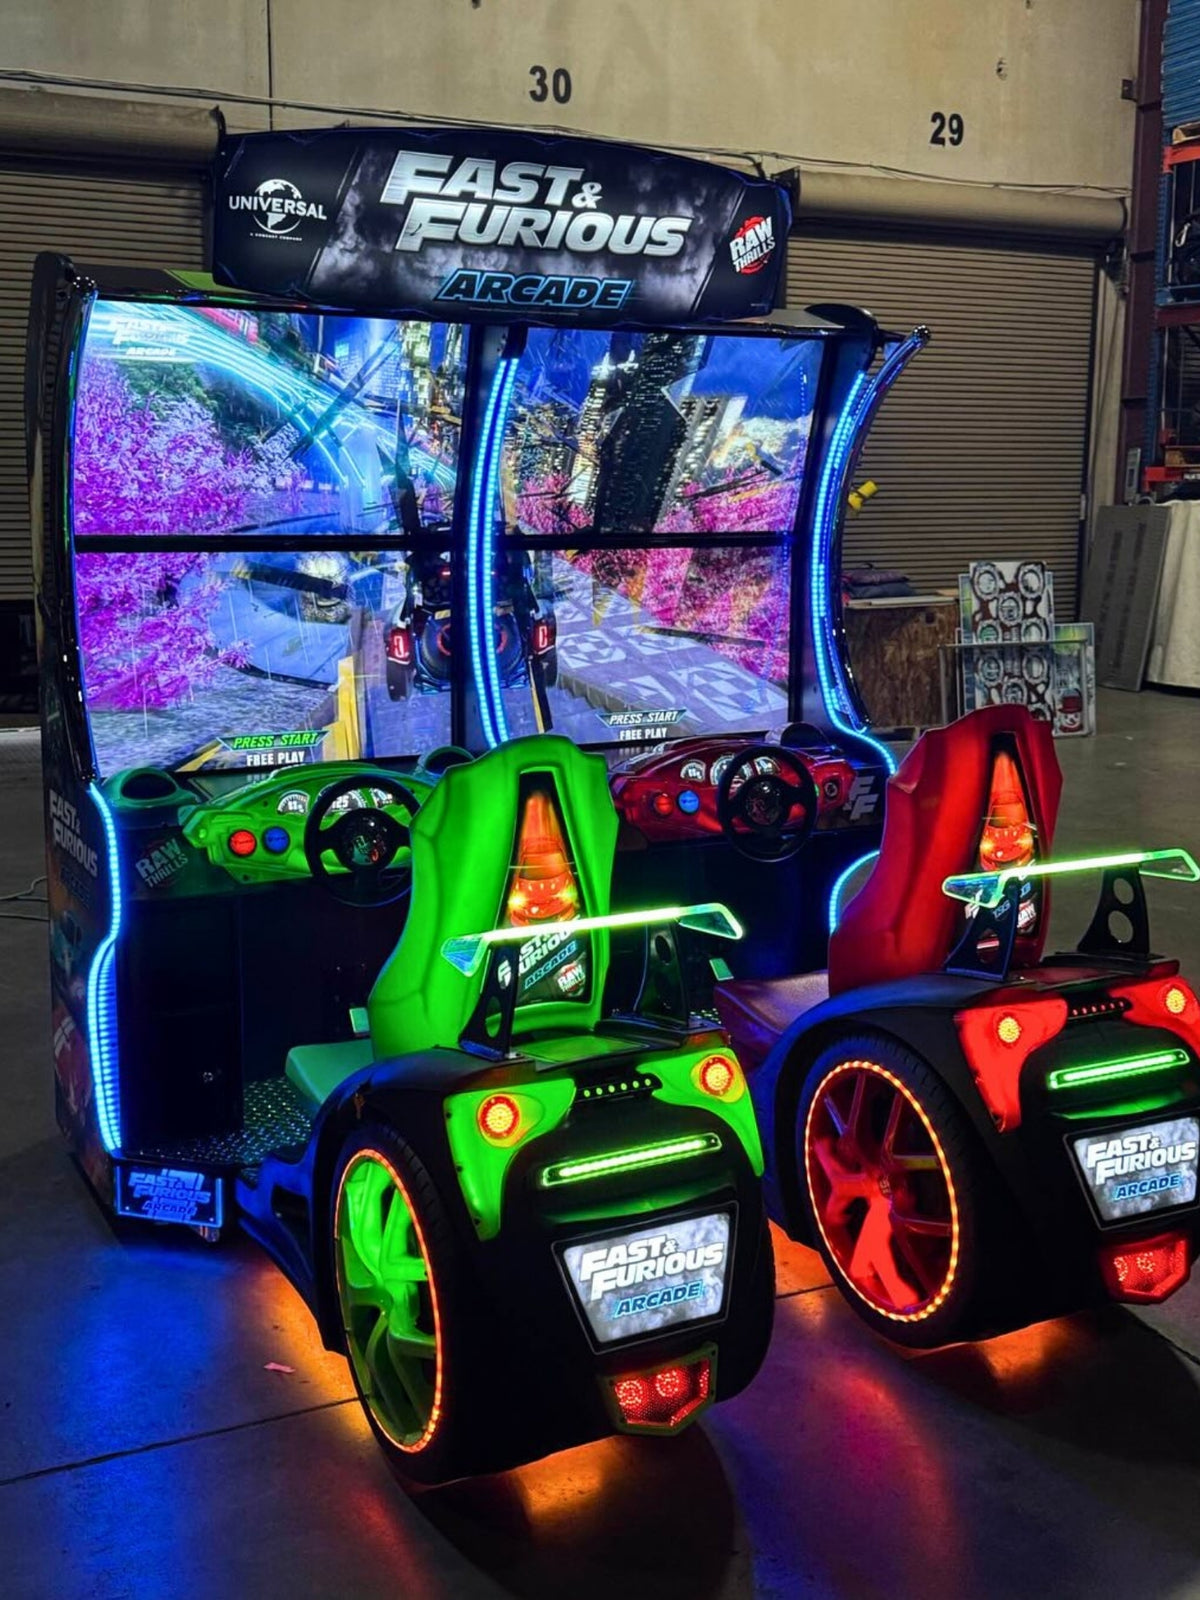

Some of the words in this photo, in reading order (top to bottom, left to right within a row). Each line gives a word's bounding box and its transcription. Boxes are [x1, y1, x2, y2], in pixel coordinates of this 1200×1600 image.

[529, 65, 572, 104] 30
[930, 111, 964, 147] 29
[380, 150, 585, 206] FAST
[229, 195, 327, 220] UNIVERSAL
[395, 197, 693, 257] FURIOUS
[730, 216, 772, 261] RAW
[733, 236, 775, 273] THRILLS
[435, 268, 633, 310] ARCADE
[609, 714, 643, 725] PRESS
[647, 711, 678, 722] START
[619, 729, 643, 740] FREE
[644, 727, 667, 739] PLAY
[233, 735, 275, 749] PRESS
[280, 732, 318, 745] START
[246, 753, 274, 766] FREE
[277, 751, 305, 764] PLAY
[53, 818, 98, 879] FURIOUS
[135, 838, 182, 879] RAW
[144, 852, 189, 888] THRILLS
[524, 940, 578, 990] ARCADE
[1086, 1133, 1152, 1168] FAST
[1095, 1142, 1196, 1186] FURIOUS
[133, 1184, 211, 1204] FURIOUS
[1114, 1173, 1182, 1200] ARCADE
[579, 1234, 667, 1282] FAST
[591, 1243, 725, 1301] FURIOUS
[613, 1280, 704, 1319] ARCADE
